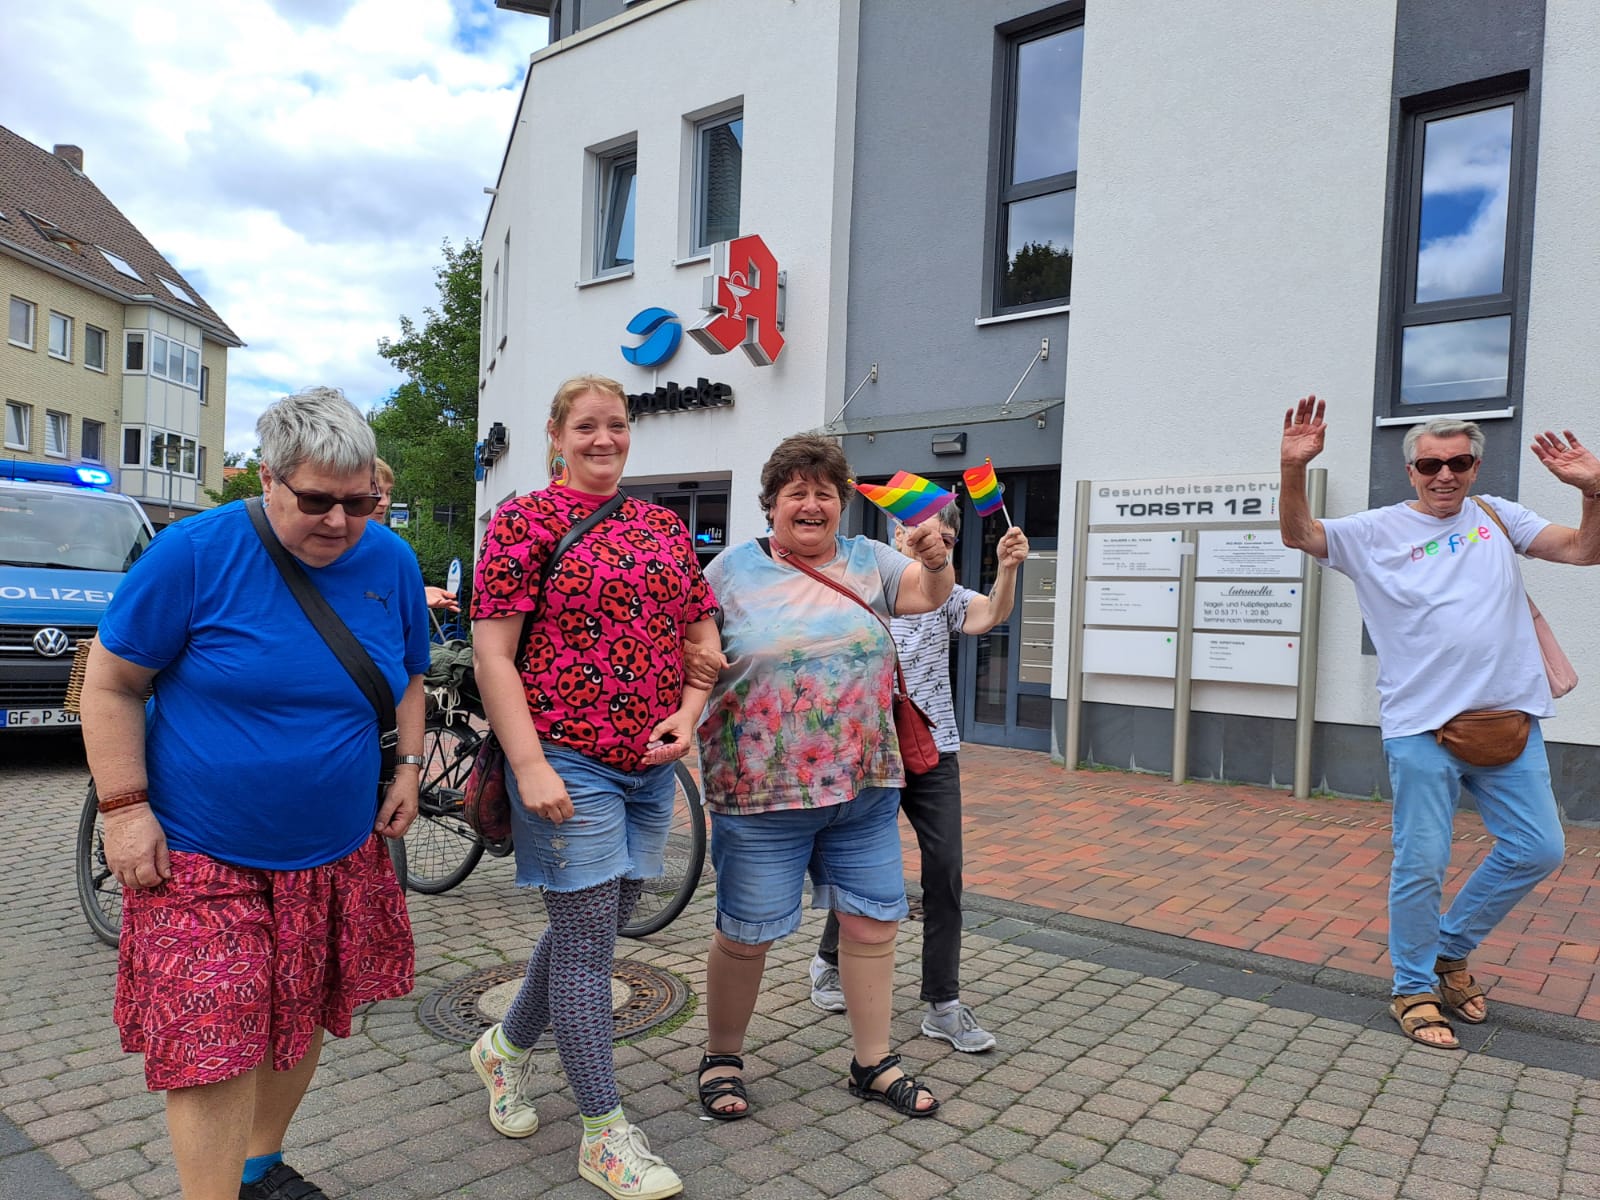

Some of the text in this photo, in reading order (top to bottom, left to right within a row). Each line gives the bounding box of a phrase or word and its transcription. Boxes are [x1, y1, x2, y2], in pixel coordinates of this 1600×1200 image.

[626, 377, 734, 422] potheke
[1099, 482, 1280, 498] Gesundheitszentru
[1116, 498, 1262, 517] TORSTR 12
[1411, 526, 1491, 562] be free
[8, 711, 30, 725] GF
[42, 710, 52, 724] P
